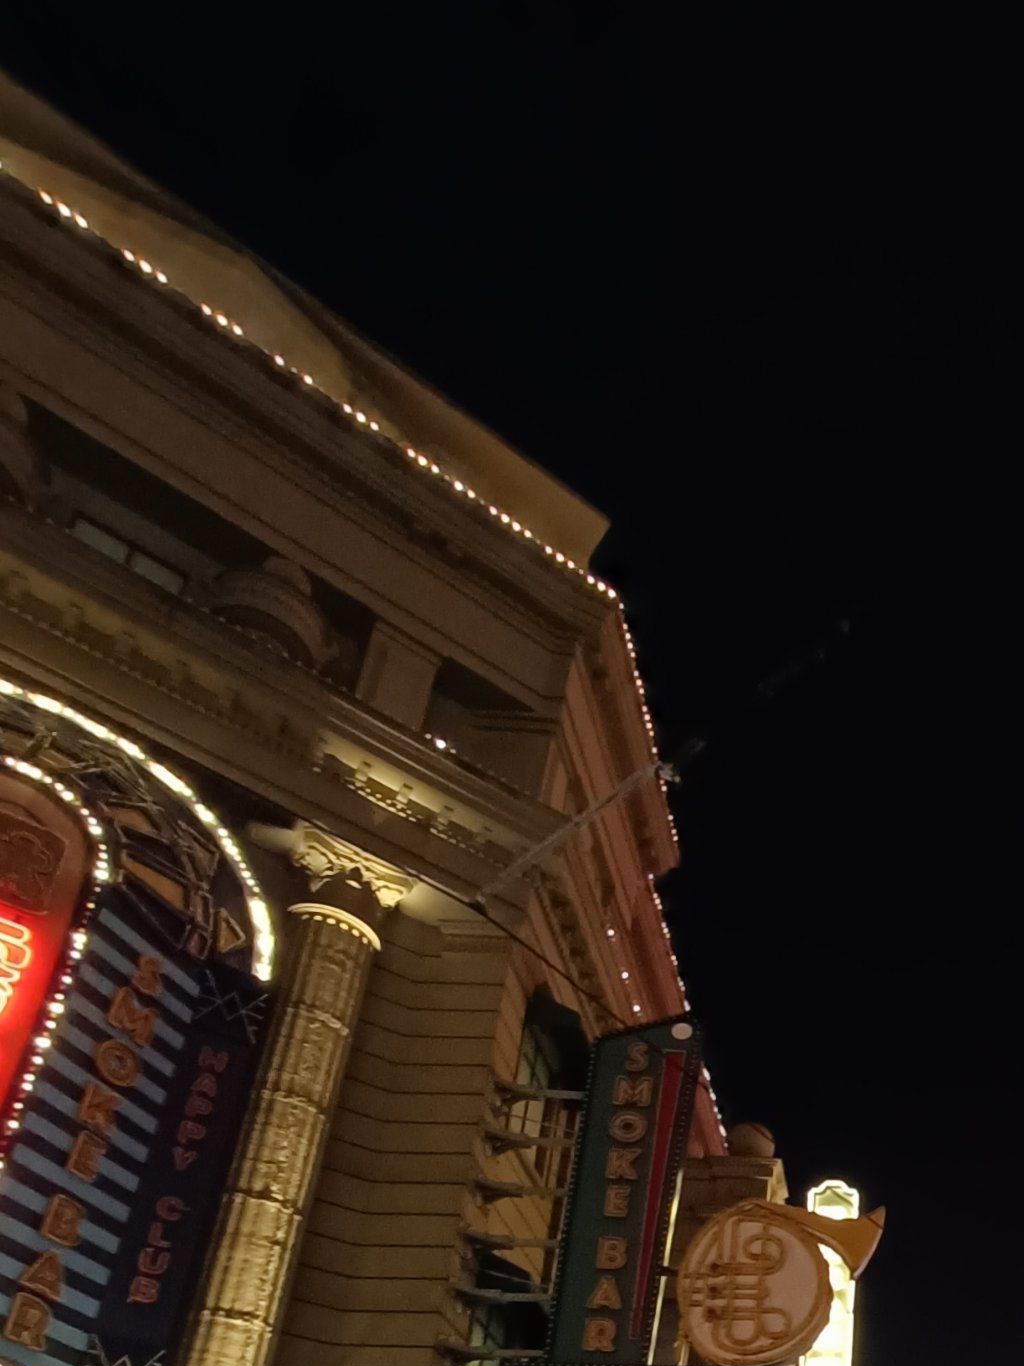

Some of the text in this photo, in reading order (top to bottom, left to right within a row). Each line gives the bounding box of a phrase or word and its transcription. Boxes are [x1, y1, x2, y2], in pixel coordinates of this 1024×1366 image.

[66, 955, 163, 1181] SMOKE
[128, 1045, 230, 1303] HAPPY CLUB
[5, 1193, 85, 1350] BAR
[583, 1042, 653, 1352] SMOKE BAR
